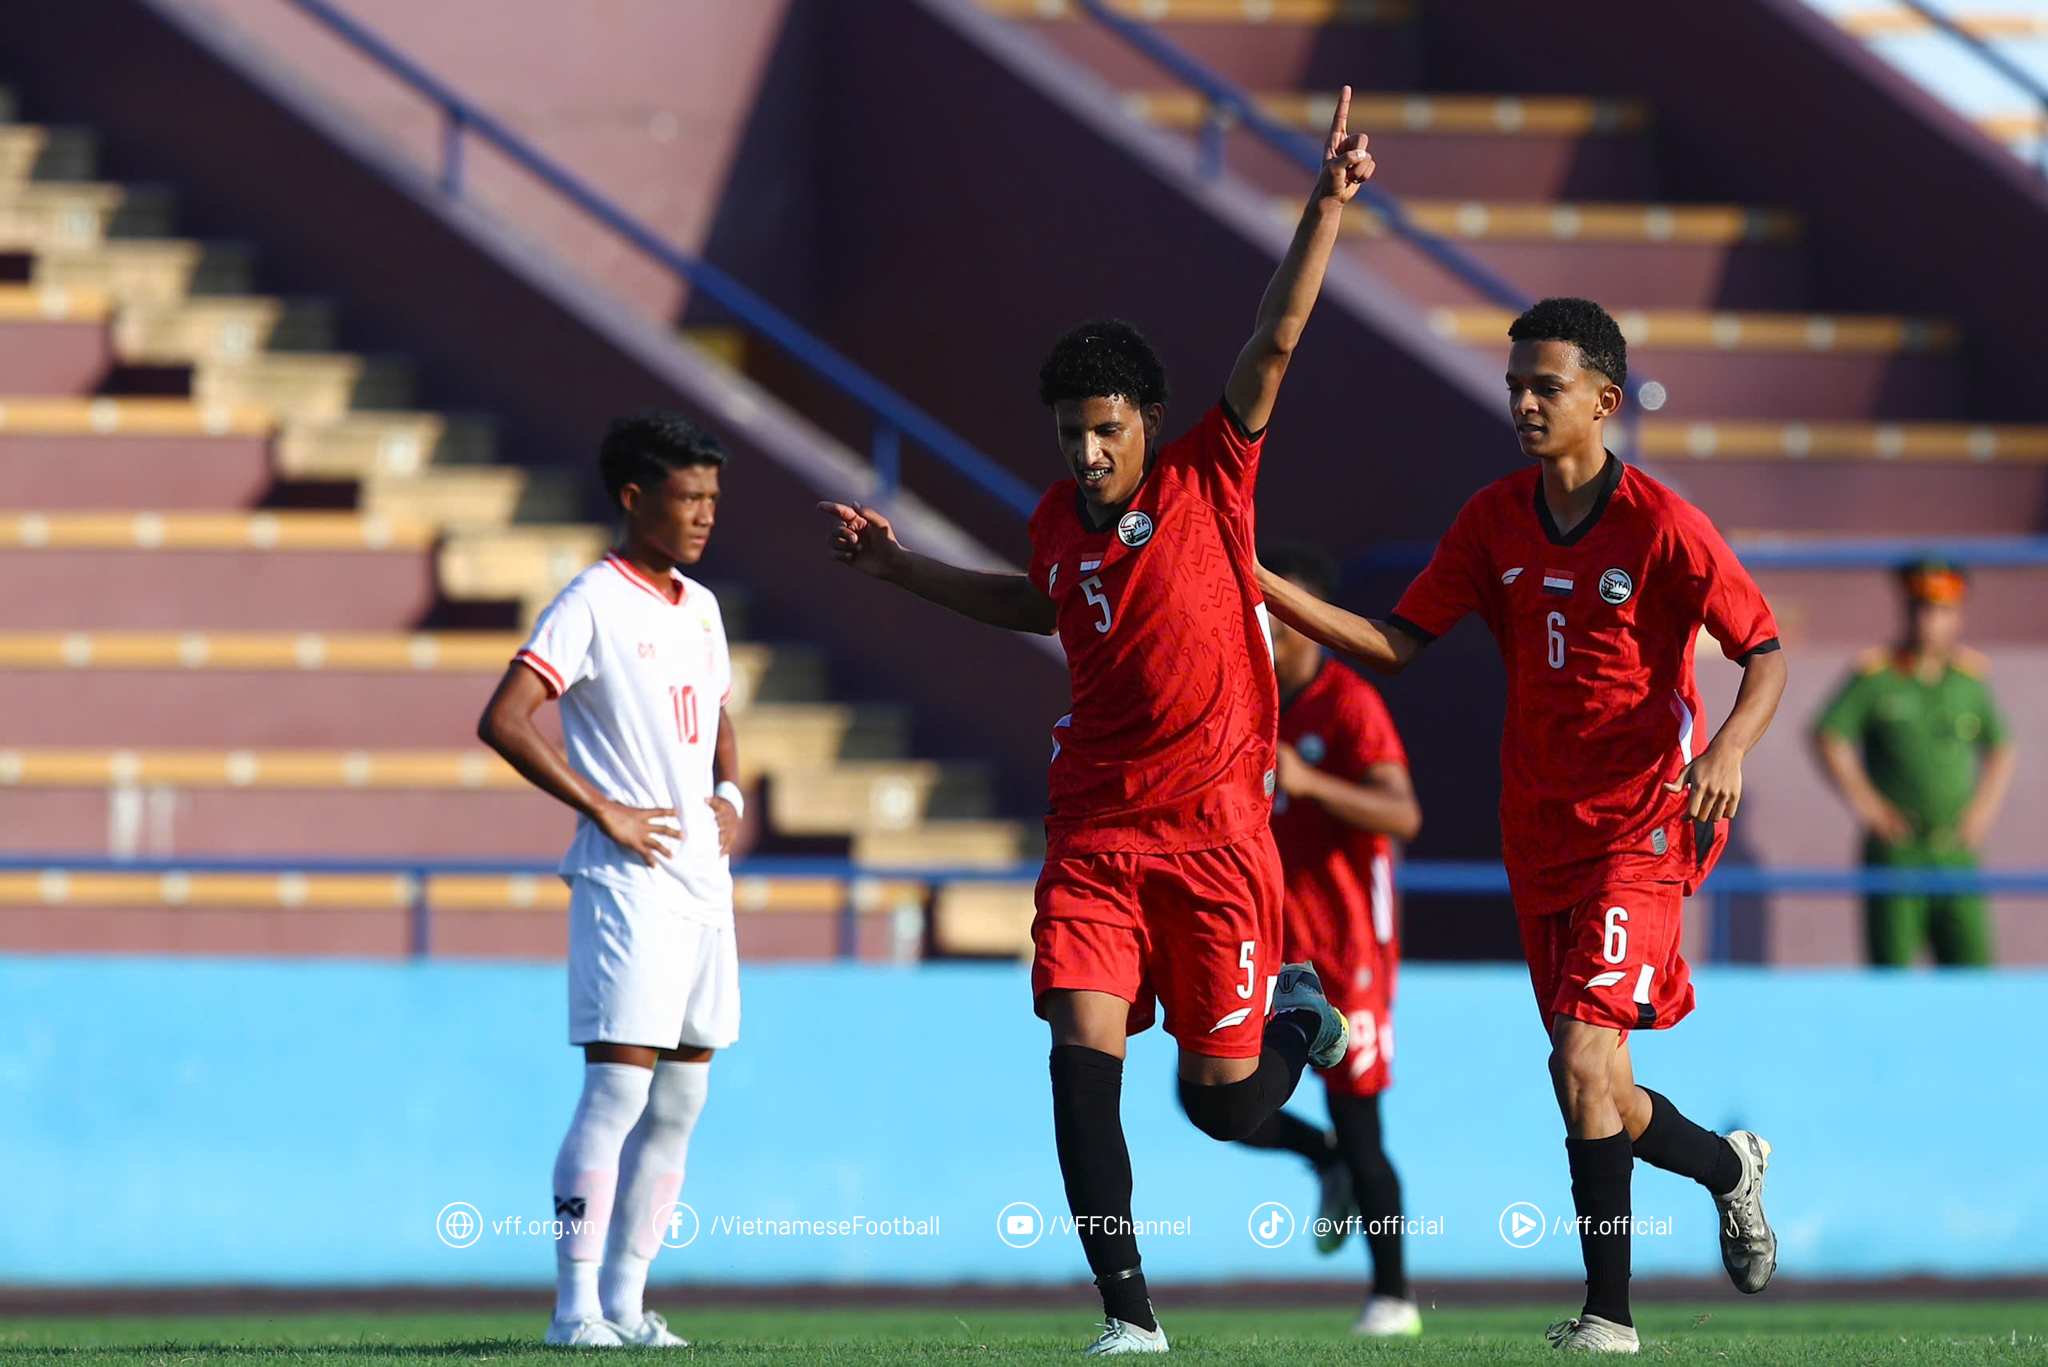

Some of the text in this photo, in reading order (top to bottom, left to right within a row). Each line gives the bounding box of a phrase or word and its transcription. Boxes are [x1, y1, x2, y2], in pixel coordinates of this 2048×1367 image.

[1132, 518, 1148, 529] YFA
[1079, 575, 1112, 634] 5
[1613, 579, 1628, 589] YFA
[1547, 610, 1566, 670] 6
[669, 685, 699, 744] 10
[1602, 906, 1629, 965] 6
[1236, 941, 1256, 1000] 5
